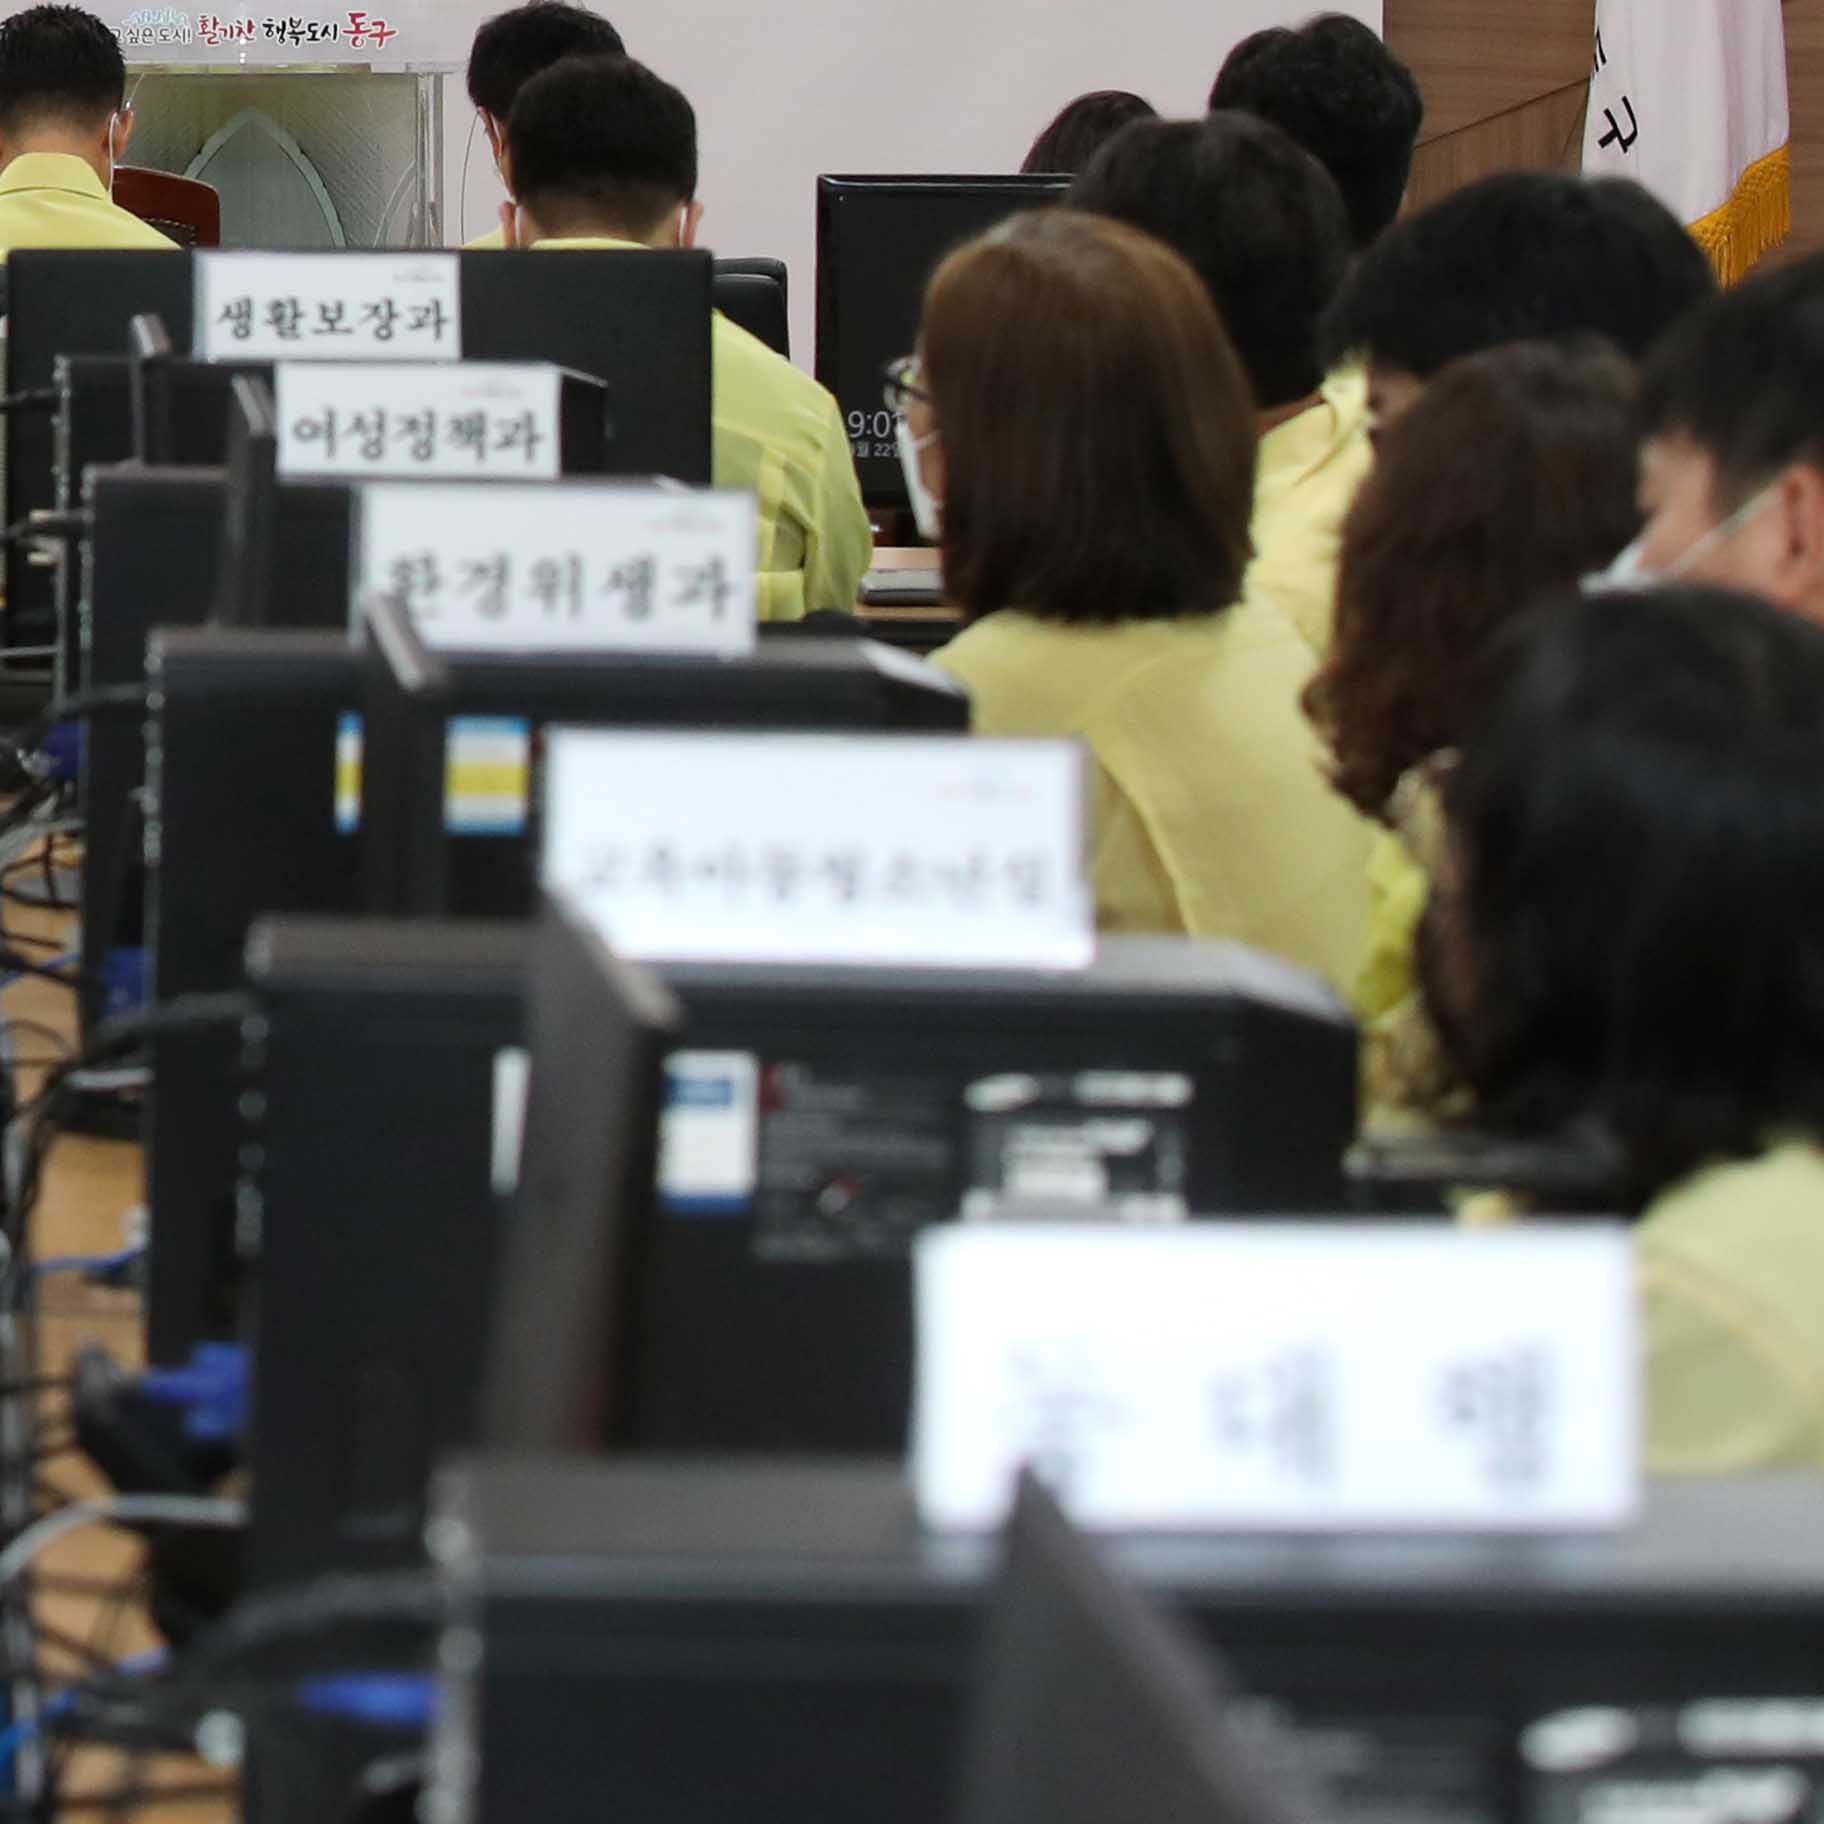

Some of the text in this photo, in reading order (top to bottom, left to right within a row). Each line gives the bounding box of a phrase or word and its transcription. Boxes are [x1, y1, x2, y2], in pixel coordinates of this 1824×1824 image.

[262, 16, 339, 47] 행복도시
[342, 12, 397, 48] 동구
[215, 295, 451, 344] 생활보장과
